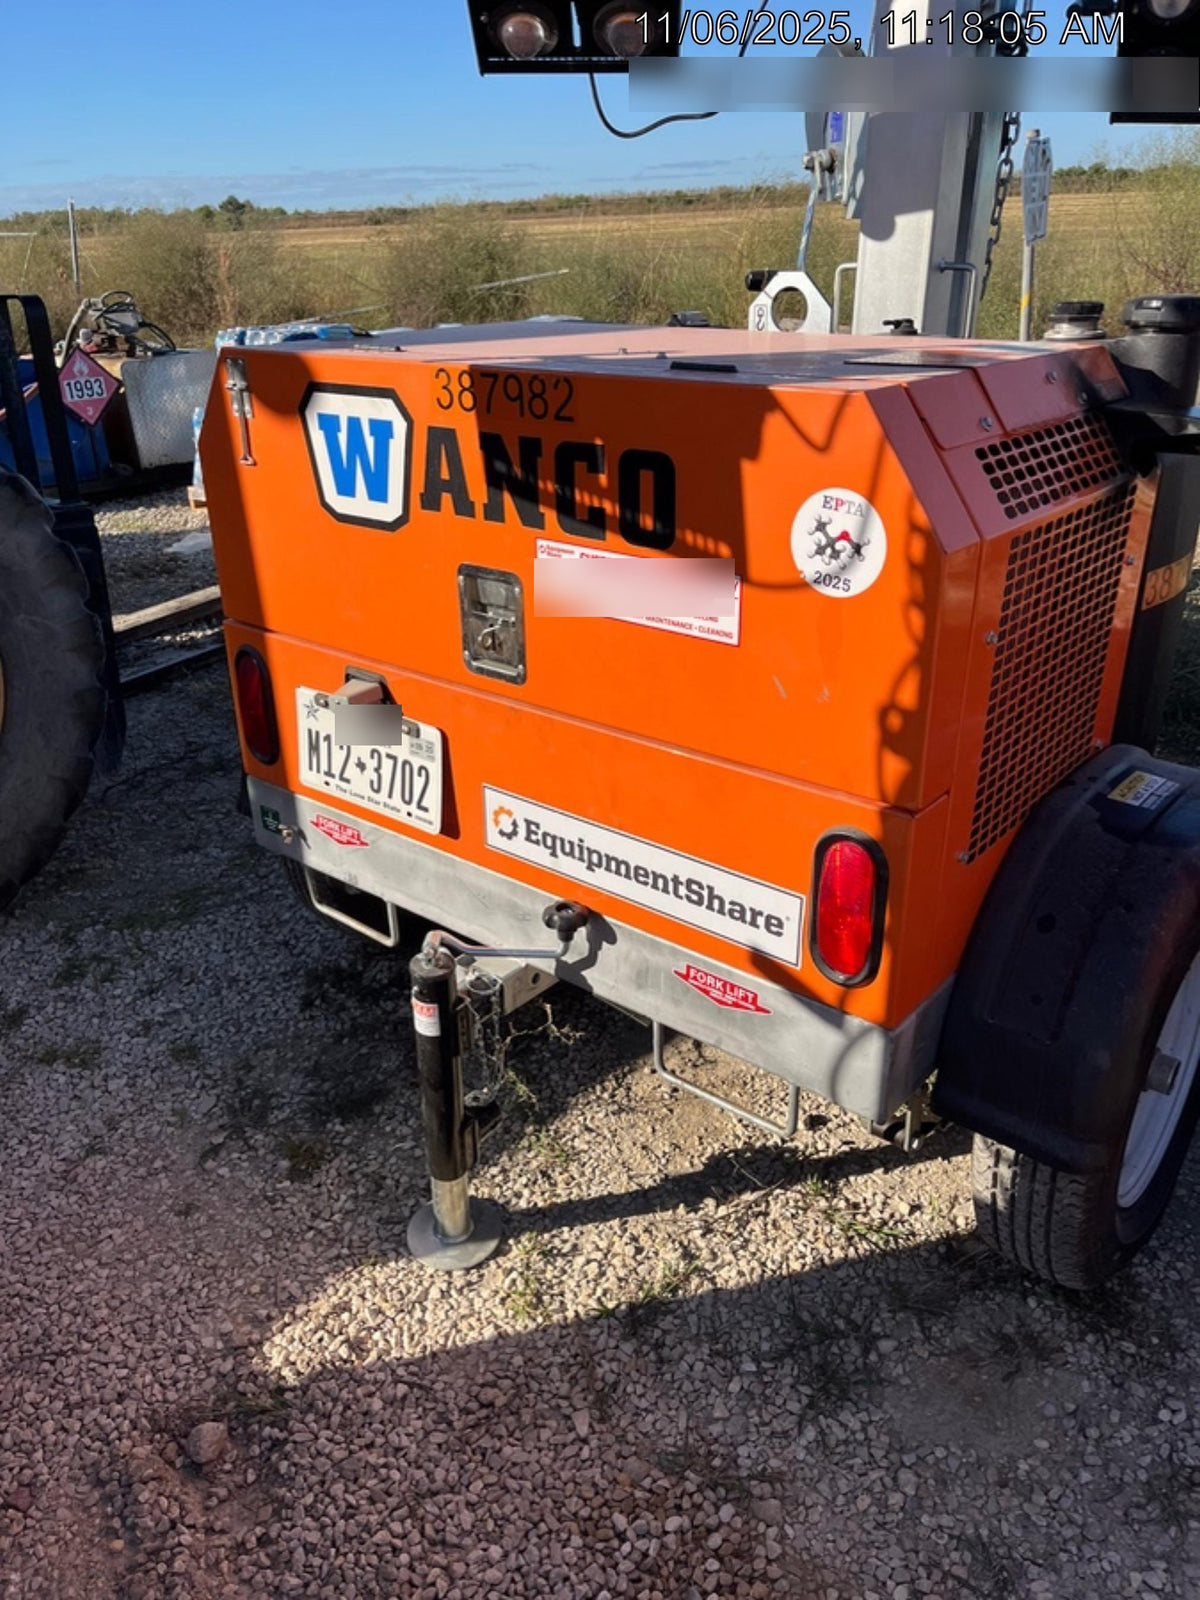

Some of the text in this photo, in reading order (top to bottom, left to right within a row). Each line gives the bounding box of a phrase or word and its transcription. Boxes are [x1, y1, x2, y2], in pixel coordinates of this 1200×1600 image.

[65, 378, 105, 400] 1993
[434, 367, 575, 423] 387982
[316, 411, 676, 551] WANCO
[822, 494, 866, 519] EPTA
[813, 569, 852, 593] 2025
[369, 747, 430, 814] 3702
[523, 818, 786, 938] EquipmentShare
[689, 967, 726, 991] FORK
[726, 983, 756, 1004] LIFT
